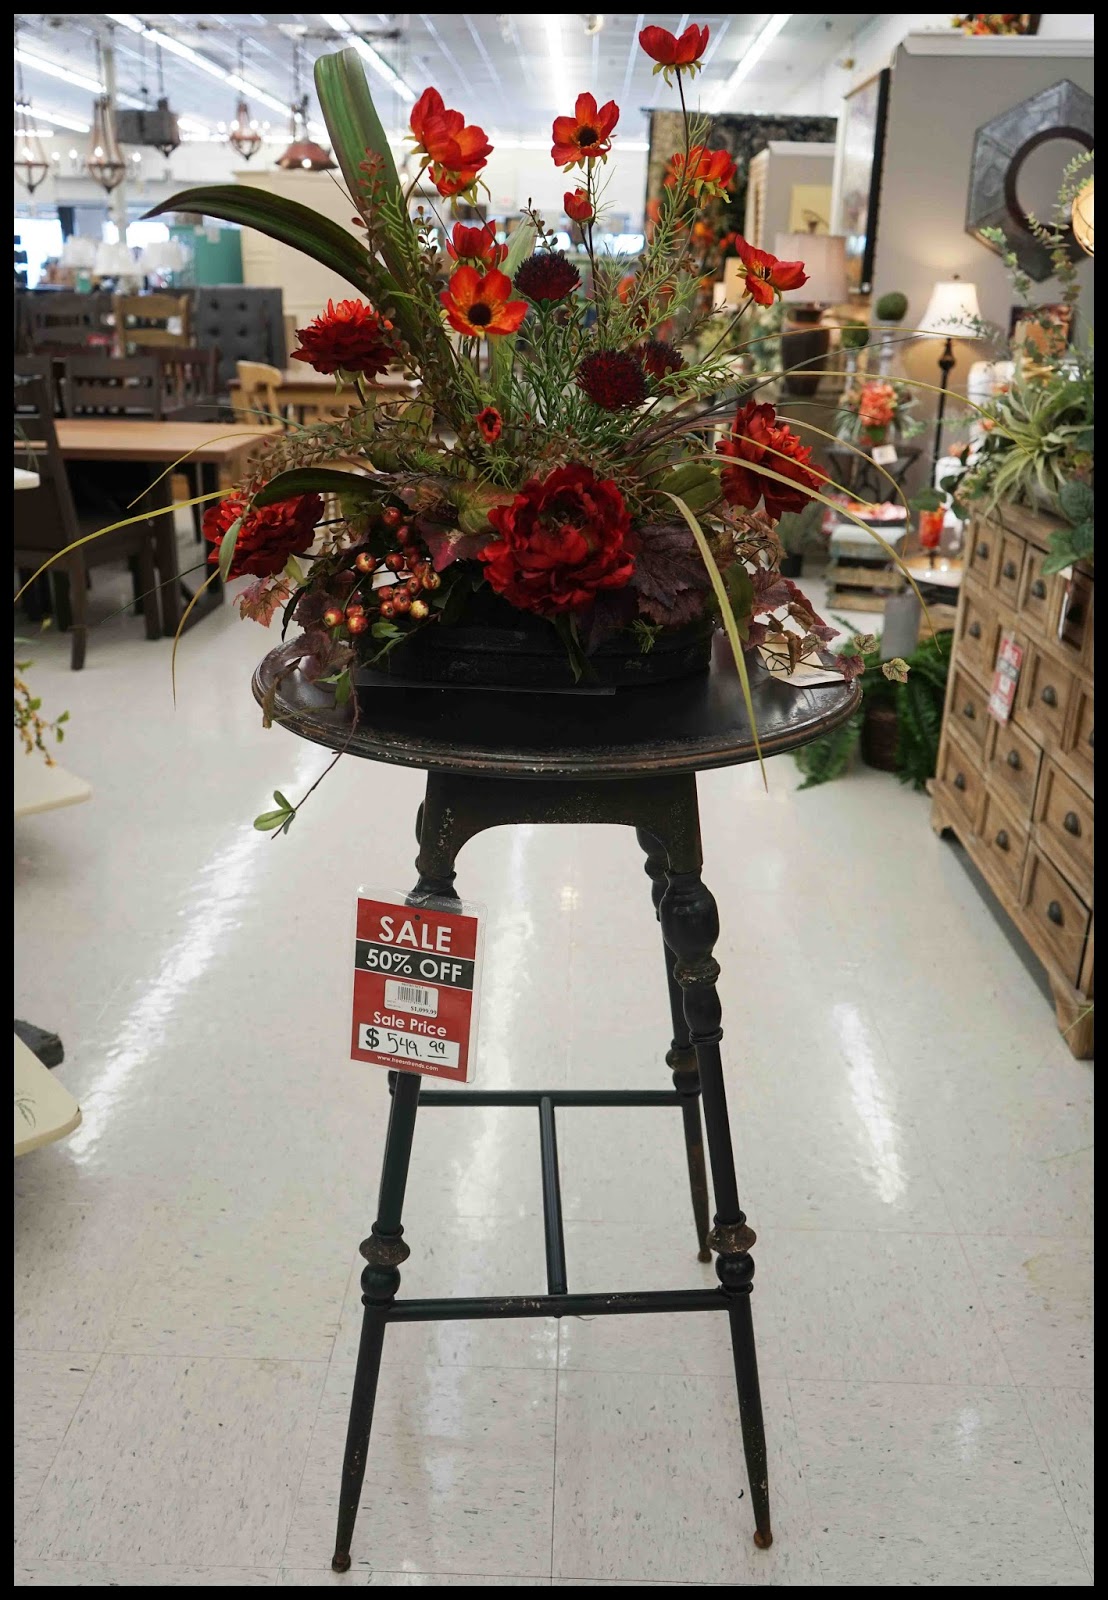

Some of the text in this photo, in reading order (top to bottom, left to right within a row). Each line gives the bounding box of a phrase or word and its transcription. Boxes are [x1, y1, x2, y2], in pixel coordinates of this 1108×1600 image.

[378, 916, 452, 953] SALE
[366, 948, 462, 983] 50% OFF
[373, 1011, 447, 1037] Sale Price
